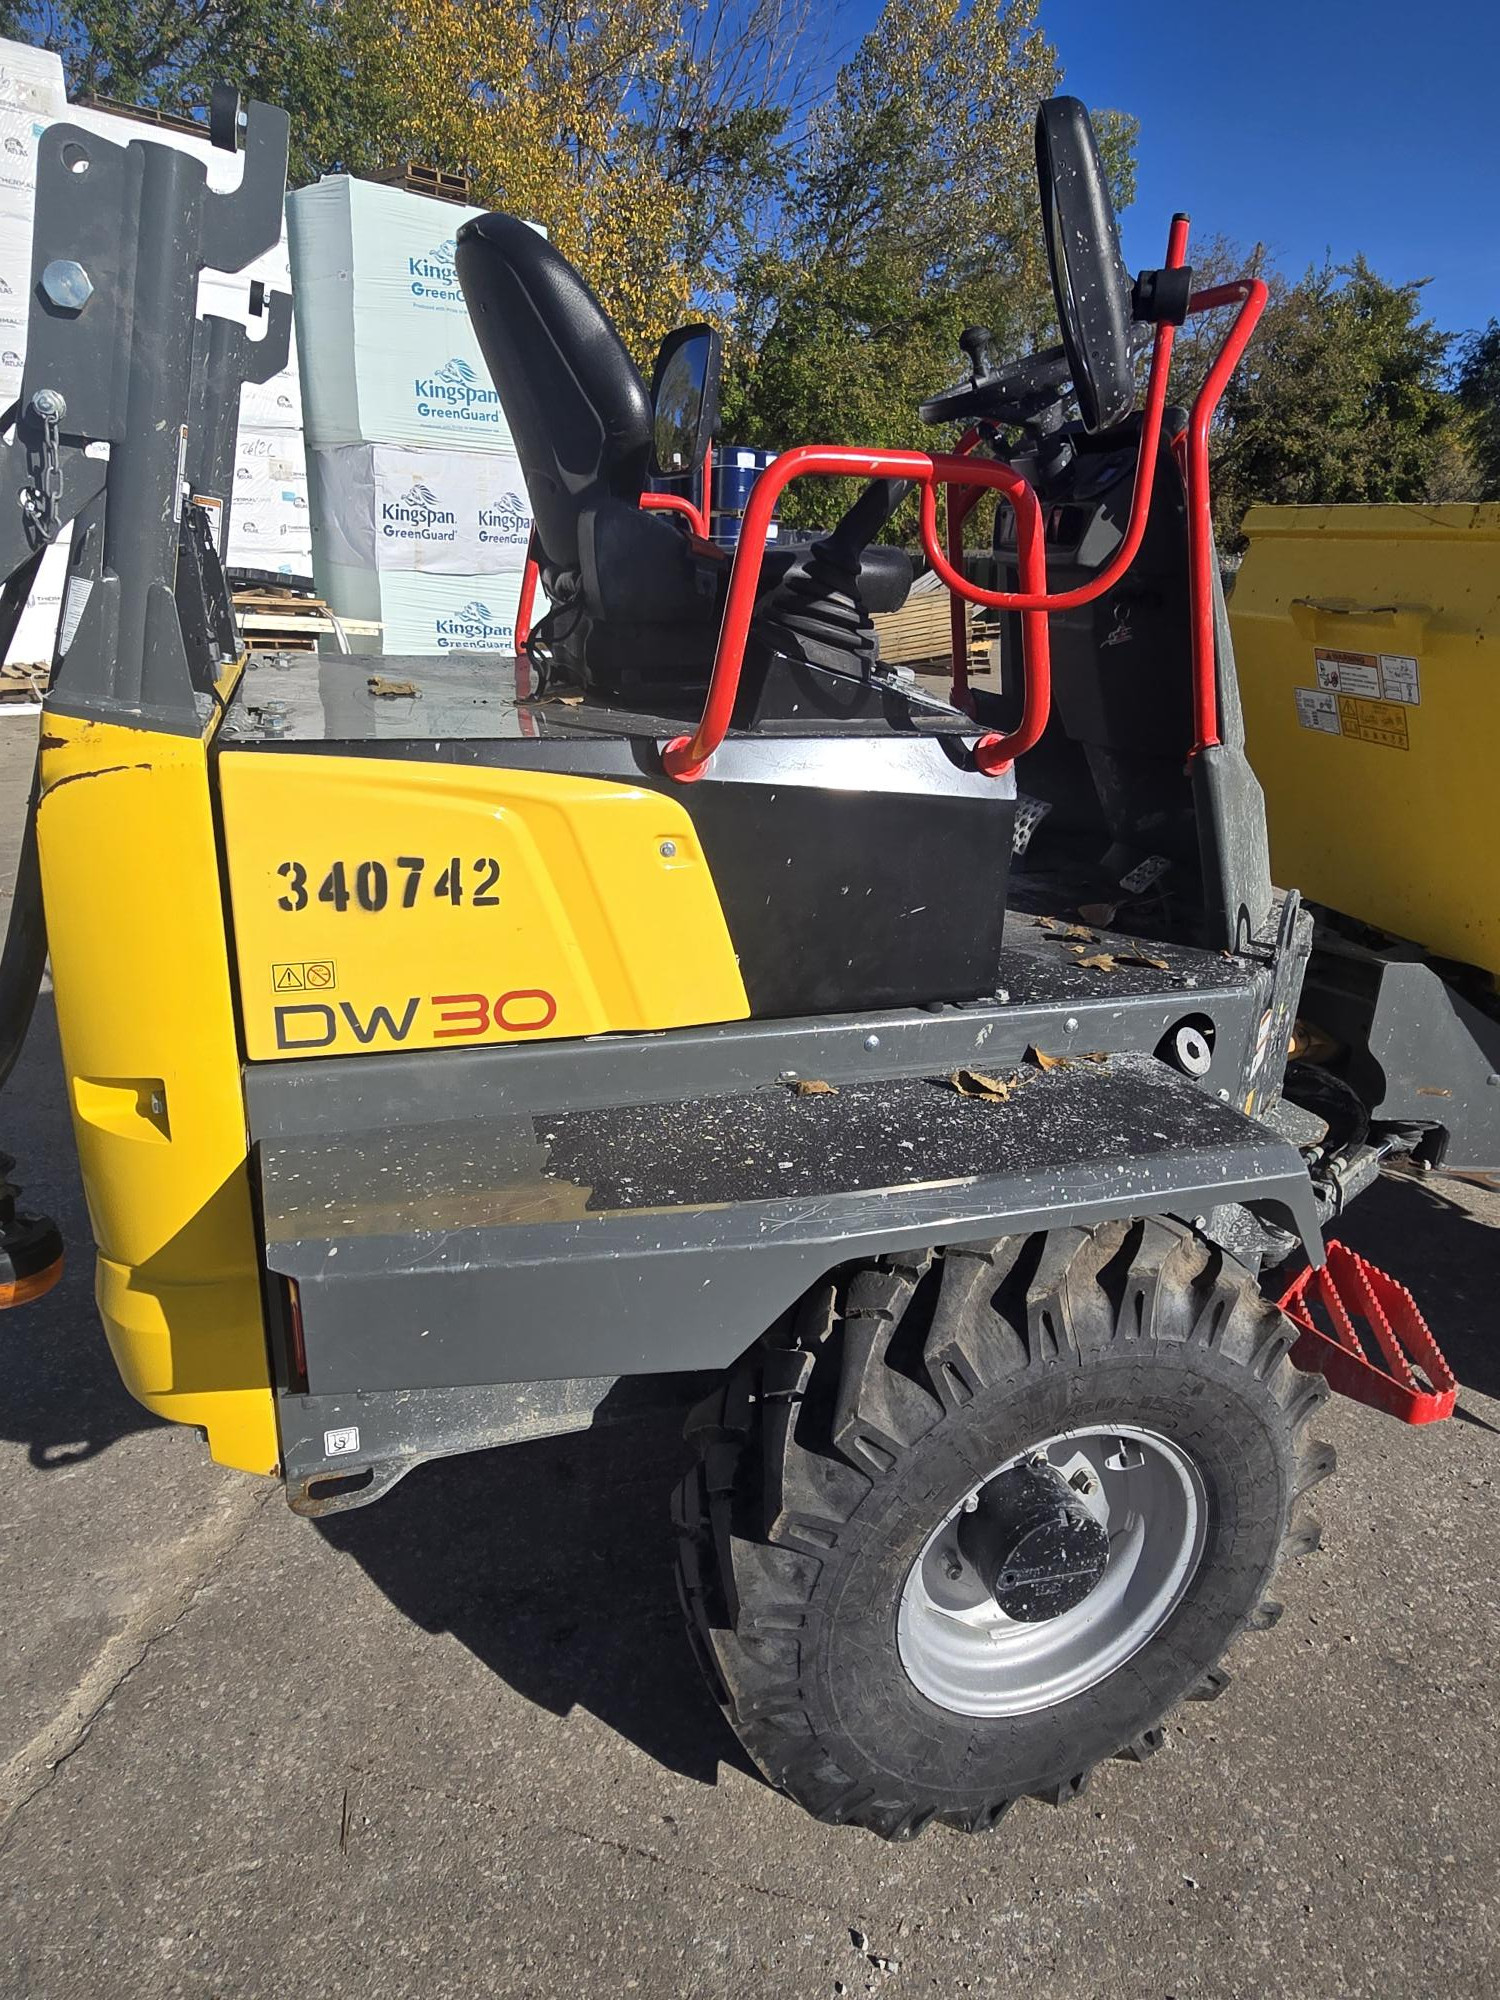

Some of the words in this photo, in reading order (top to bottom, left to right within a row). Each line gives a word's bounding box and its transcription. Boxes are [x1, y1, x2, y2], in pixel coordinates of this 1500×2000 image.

[409, 257, 460, 286] Kings
[411, 282, 466, 302] GreenG
[415, 379, 498, 406] Kingspan
[417, 402, 500, 422] GreenGuard
[382, 503, 455, 527] Kingspan
[383, 524, 456, 541] GreenGuard
[479, 530, 528, 544] GreenGua
[436, 619, 512, 638] Kingspan
[437, 637, 513, 649] GreenGuard
[277, 856, 500, 913] 340742
[274, 989, 557, 1050] DW30
